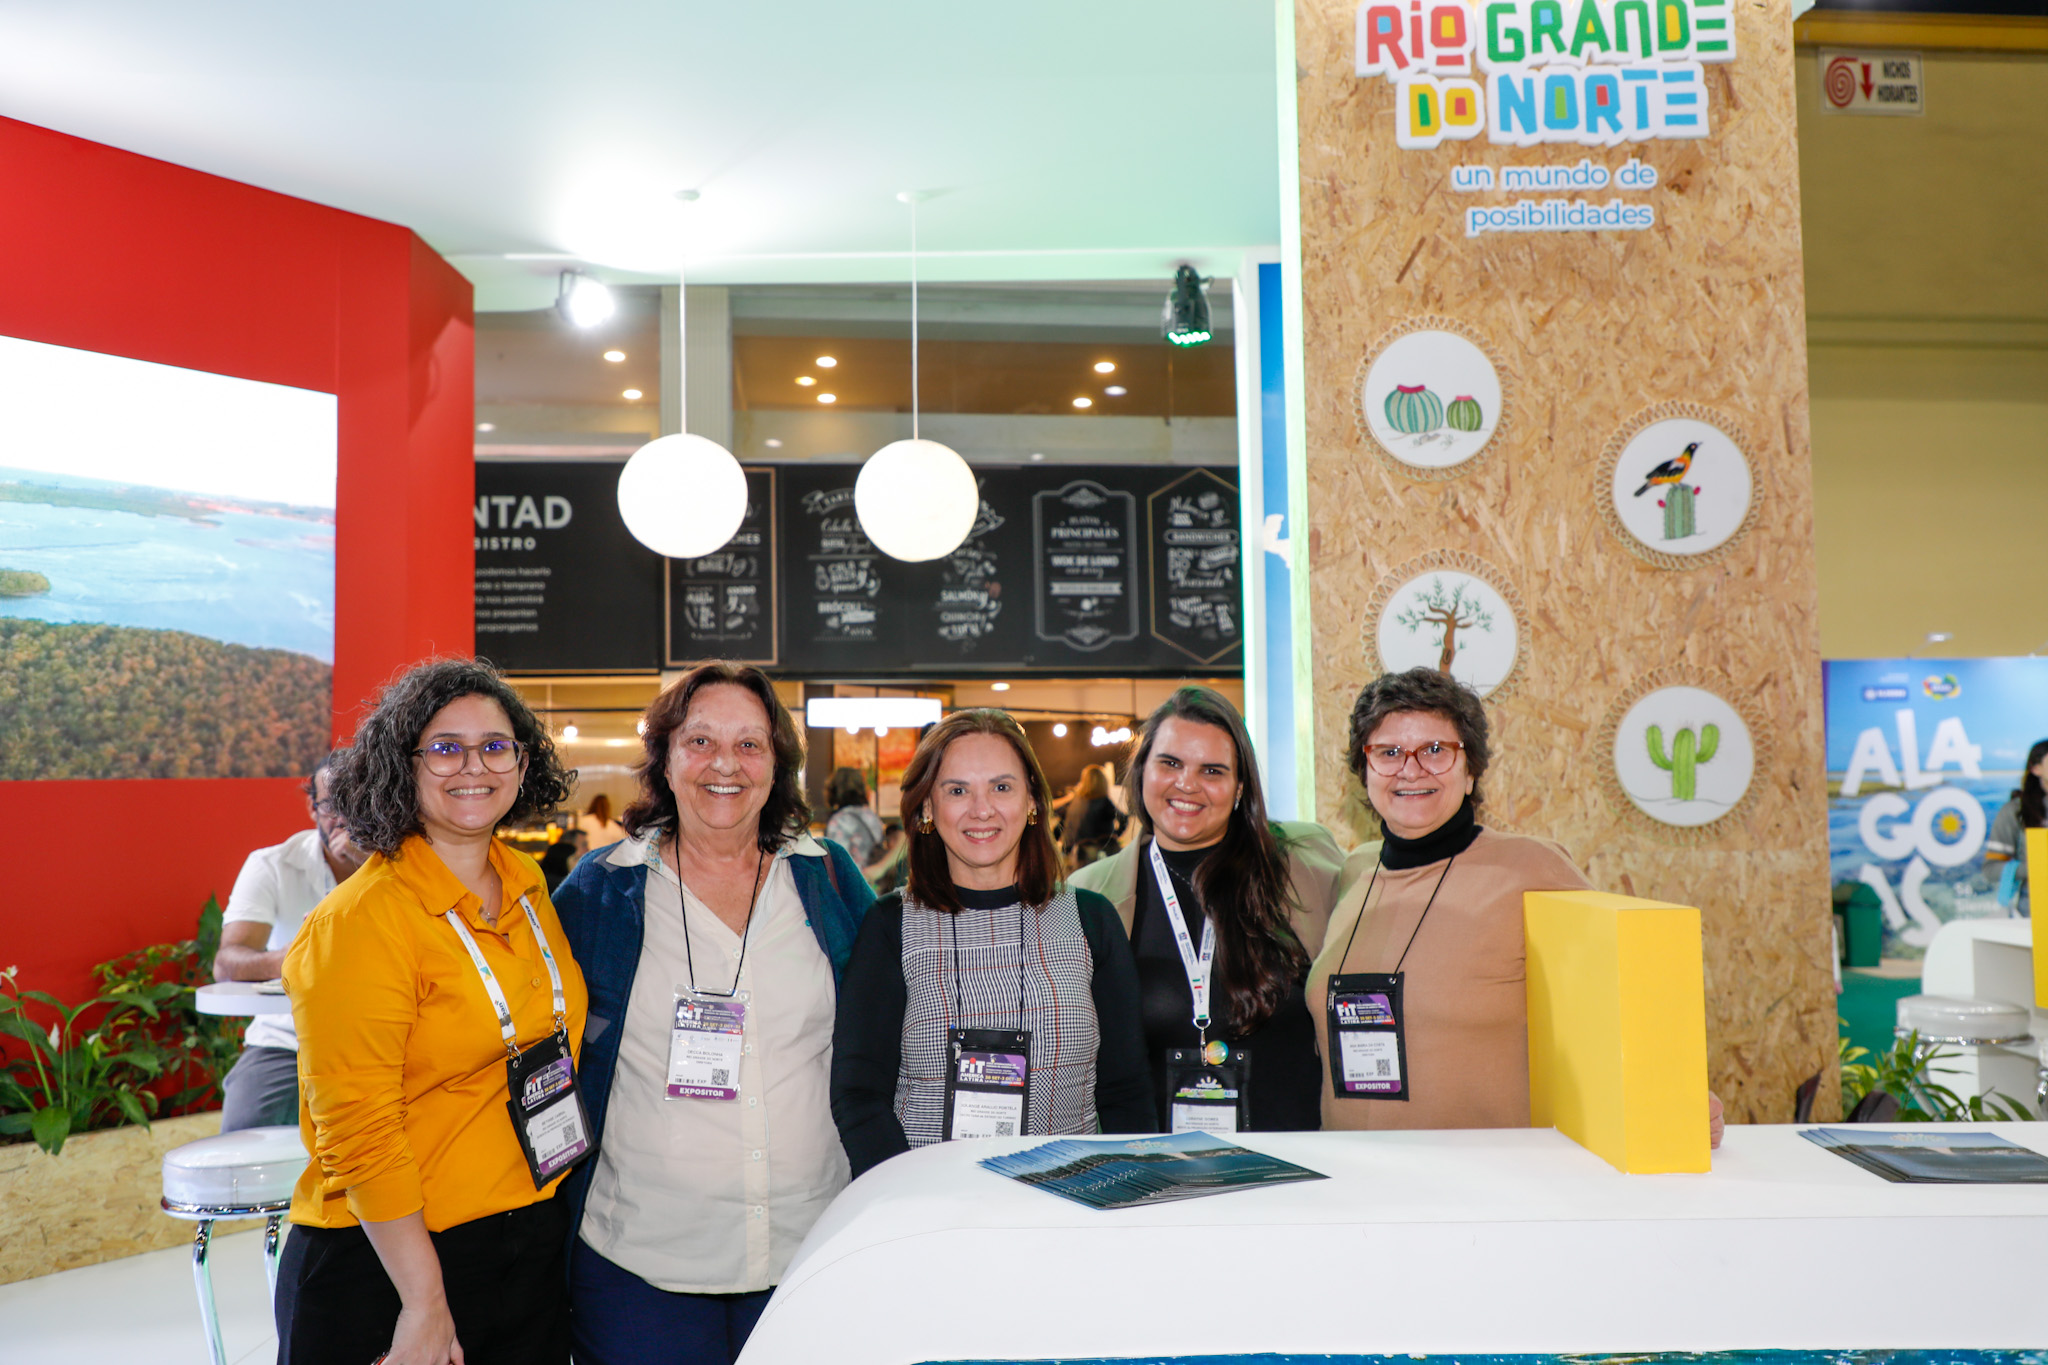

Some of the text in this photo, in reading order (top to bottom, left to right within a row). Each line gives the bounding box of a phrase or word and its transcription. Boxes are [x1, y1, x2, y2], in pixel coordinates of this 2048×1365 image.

[1486, 0, 1728, 63] GRANDE
[1409, 69, 1698, 138] DO NORTE
[1455, 160, 1656, 186] un mundo de
[1471, 204, 1652, 231] posibilidades
[474, 495, 573, 529] NTAD
[1051, 527, 1120, 538] PRINCIPALES
[680, 1087, 724, 1097] EXPOSITOR
[548, 1146, 578, 1168] EXPOSITOR
